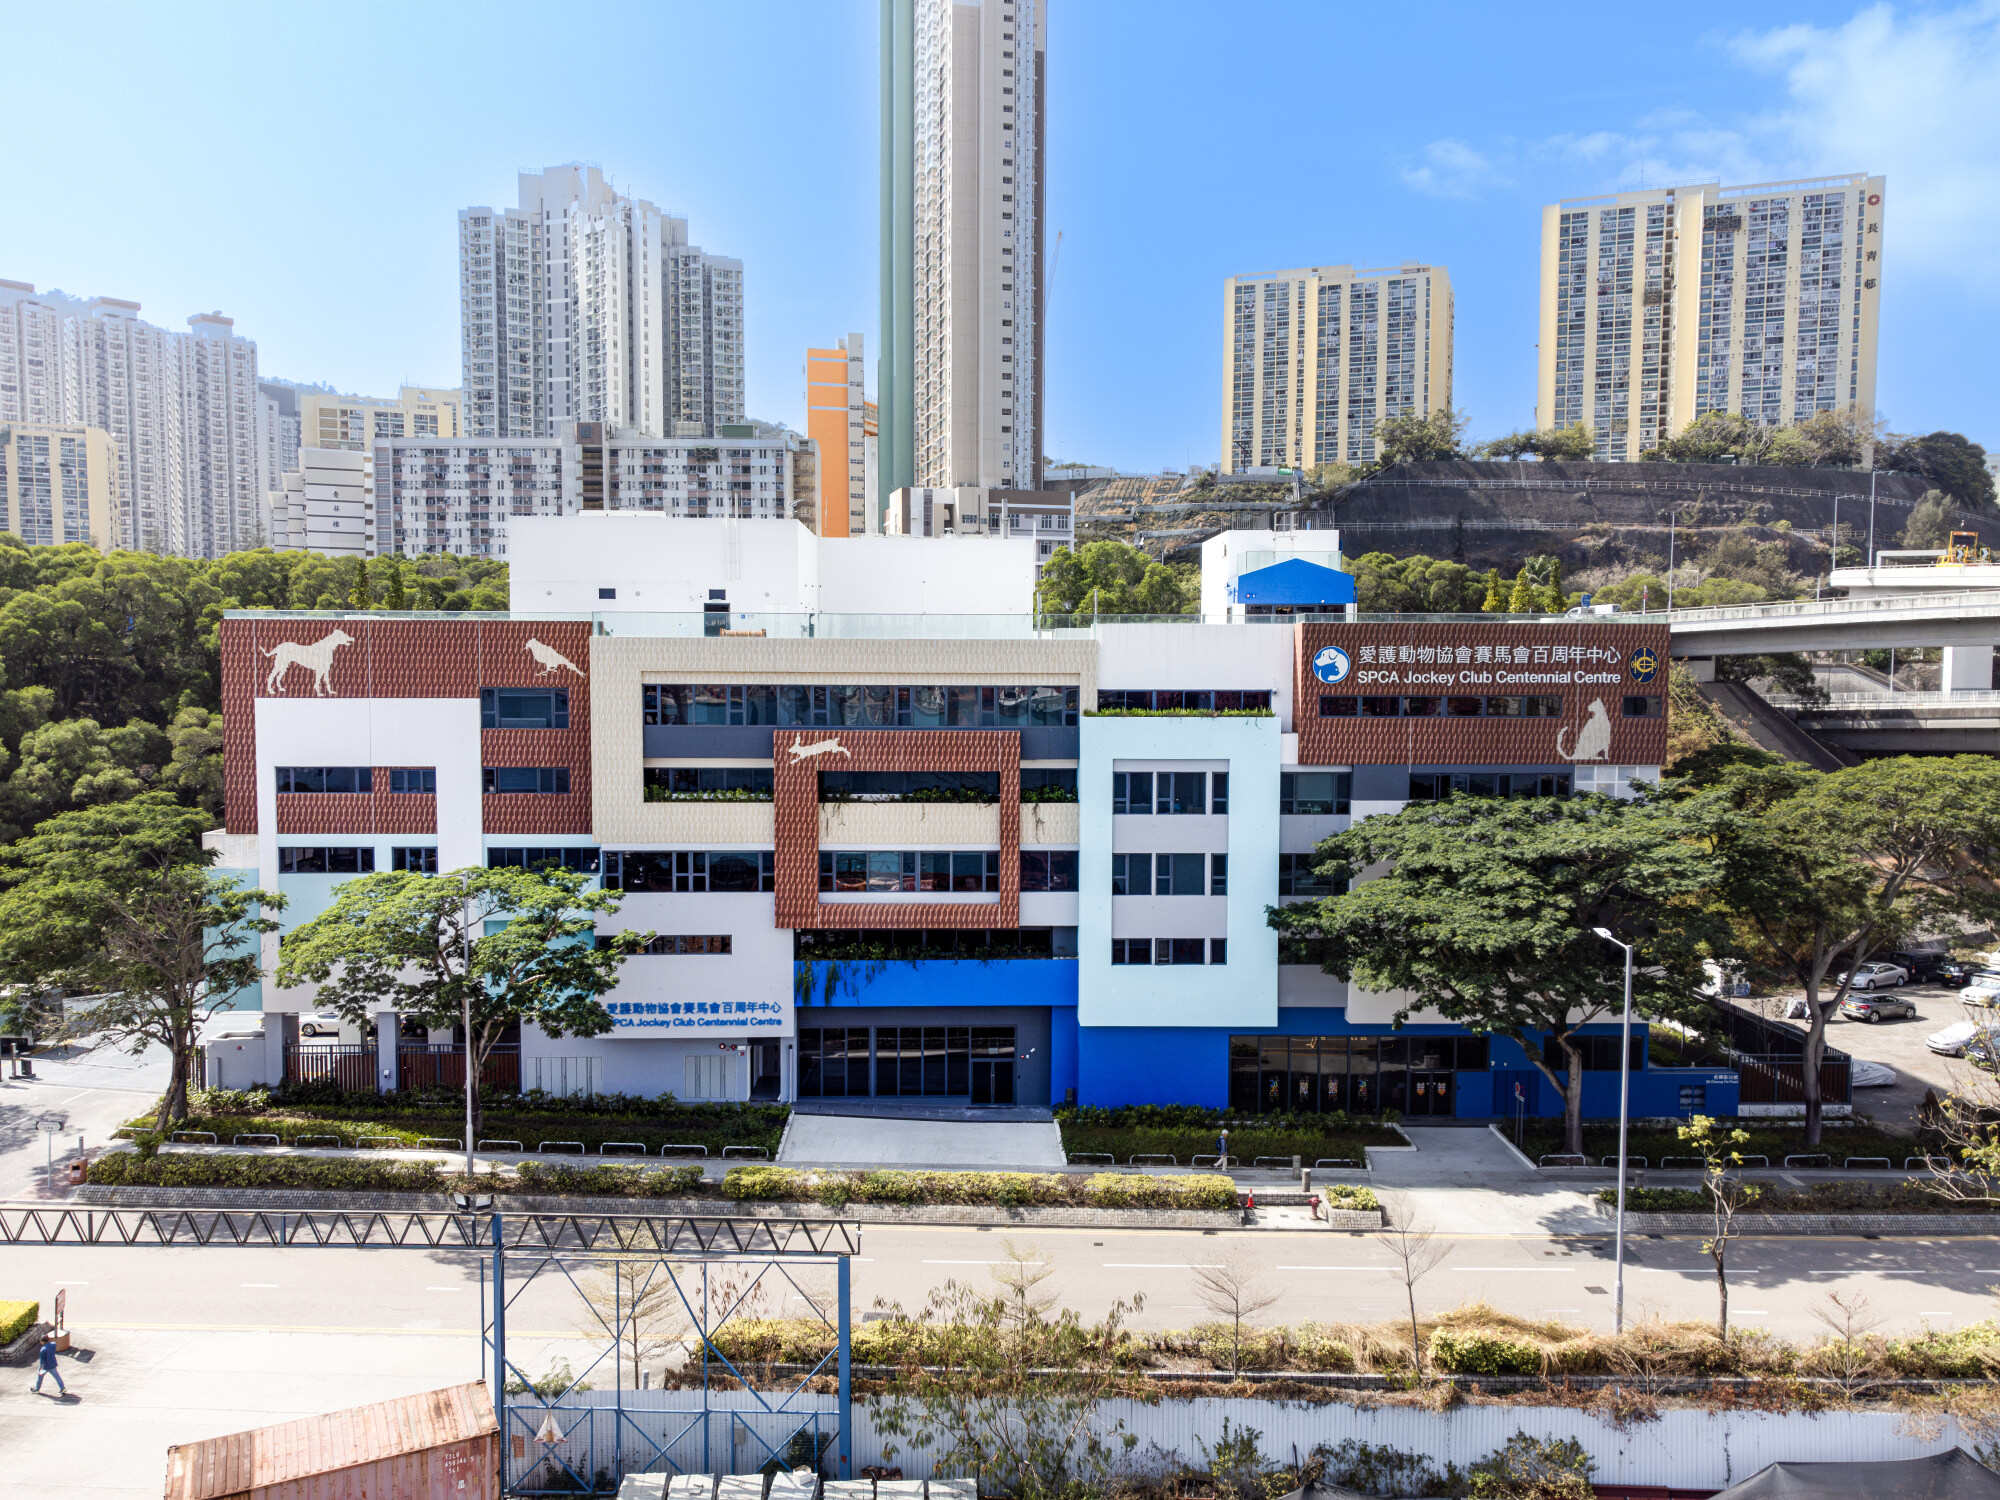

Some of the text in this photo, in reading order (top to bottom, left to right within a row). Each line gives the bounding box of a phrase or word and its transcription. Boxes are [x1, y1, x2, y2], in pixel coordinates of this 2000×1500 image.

[1358, 645, 1622, 664] 愛護動物協會賽馬會百周年中心
[1358, 671, 1621, 687] SPCA Jockey Club Centennial Centre
[613, 1017, 782, 1028] PCA Jockey Club Centennial Centre
